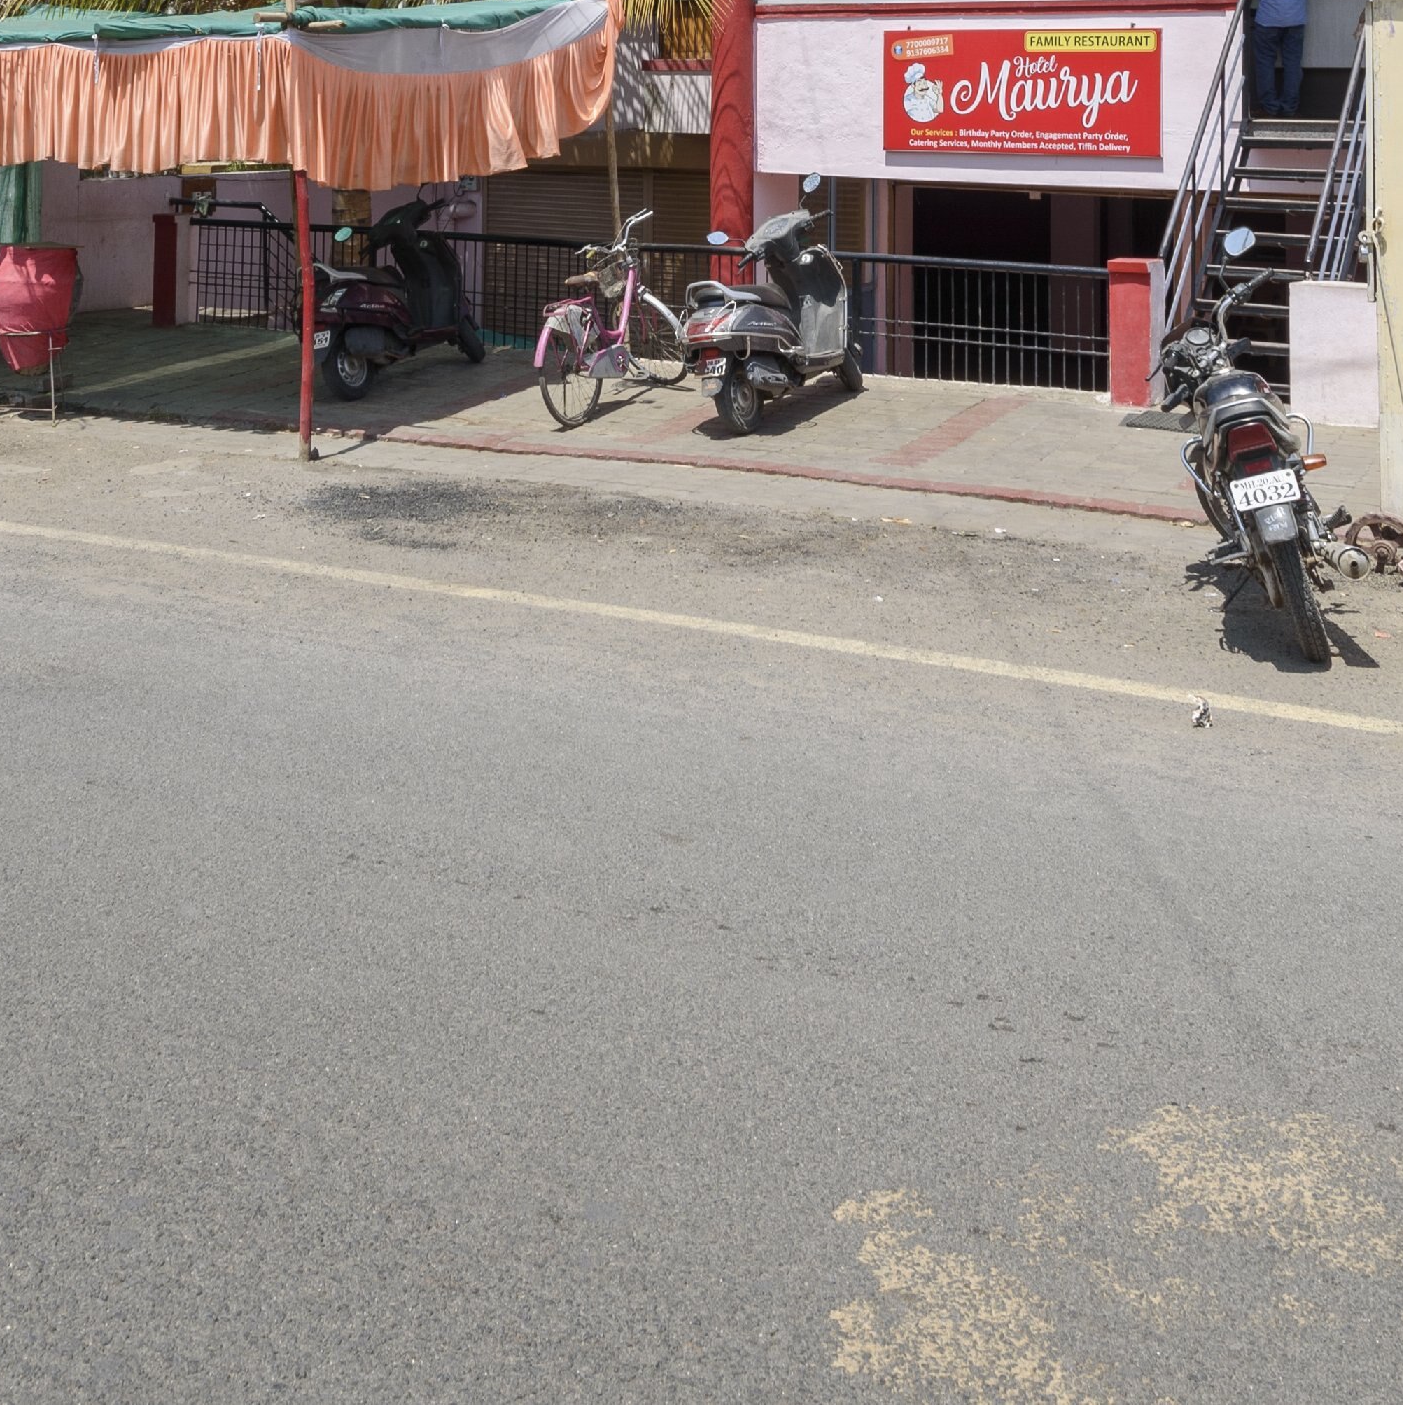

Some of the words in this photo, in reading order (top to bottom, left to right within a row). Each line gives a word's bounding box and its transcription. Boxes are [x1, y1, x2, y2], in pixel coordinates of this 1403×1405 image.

[1029, 35, 1072, 47] FAMILY
[1074, 35, 1151, 47] RESTAURANT
[1012, 55, 1058, 77] Hotel
[950, 60, 1138, 128] Maurya
[910, 128, 923, 136] Our
[924, 128, 953, 137] Services
[959, 129, 989, 138] Birthday
[990, 129, 1009, 139] Party
[1010, 130, 1034, 139] Order,
[1036, 131, 1081, 140] Engagement
[1082, 132, 1103, 141] Party
[1104, 131, 1129, 142] Order,
[909, 138, 938, 148] Catering
[938, 139, 970, 148] Services,
[971, 140, 1002, 149] Monthly
[1003, 140, 1038, 149] Members
[1077, 142, 1097, 150] Tiffin
[1098, 143, 1131, 153] Delivery
[1239, 482, 1297, 506] 4032
